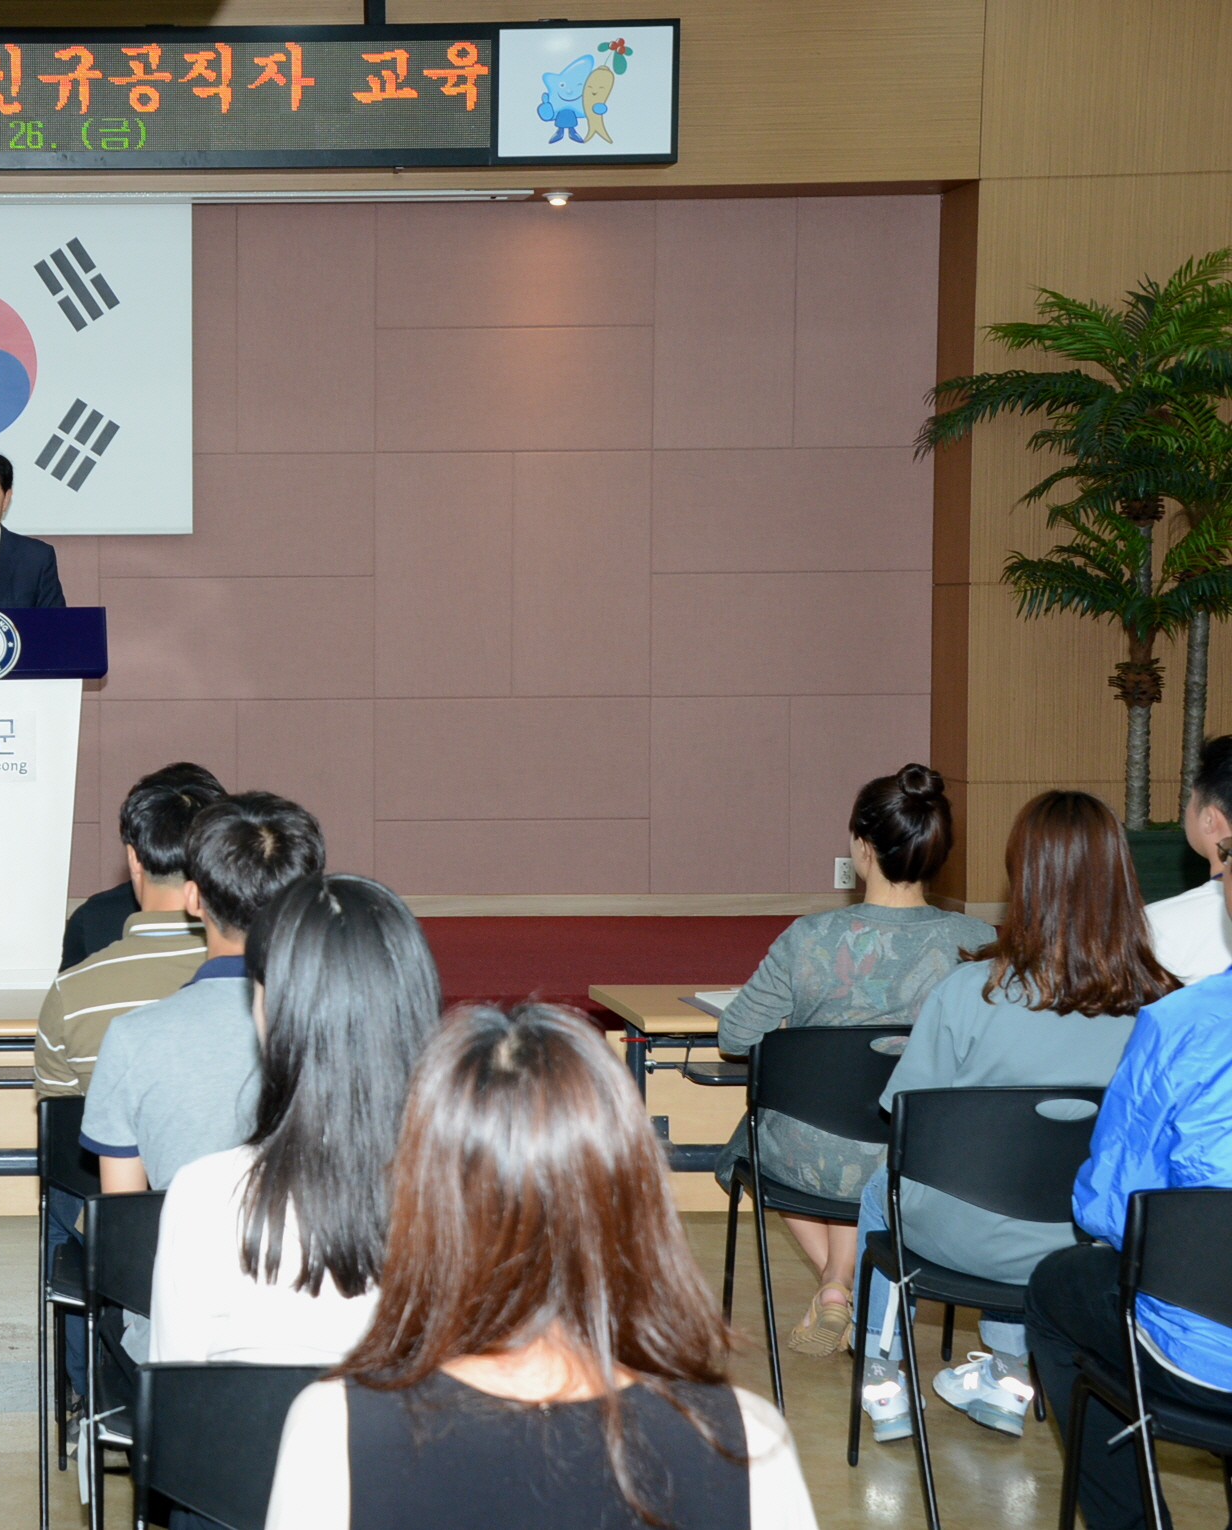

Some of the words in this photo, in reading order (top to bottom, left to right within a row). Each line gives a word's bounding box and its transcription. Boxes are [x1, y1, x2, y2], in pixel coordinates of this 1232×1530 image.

[352, 42, 489, 112] 교육
[9, 120, 58, 150] 26.
[80, 117, 148, 150] (금)
